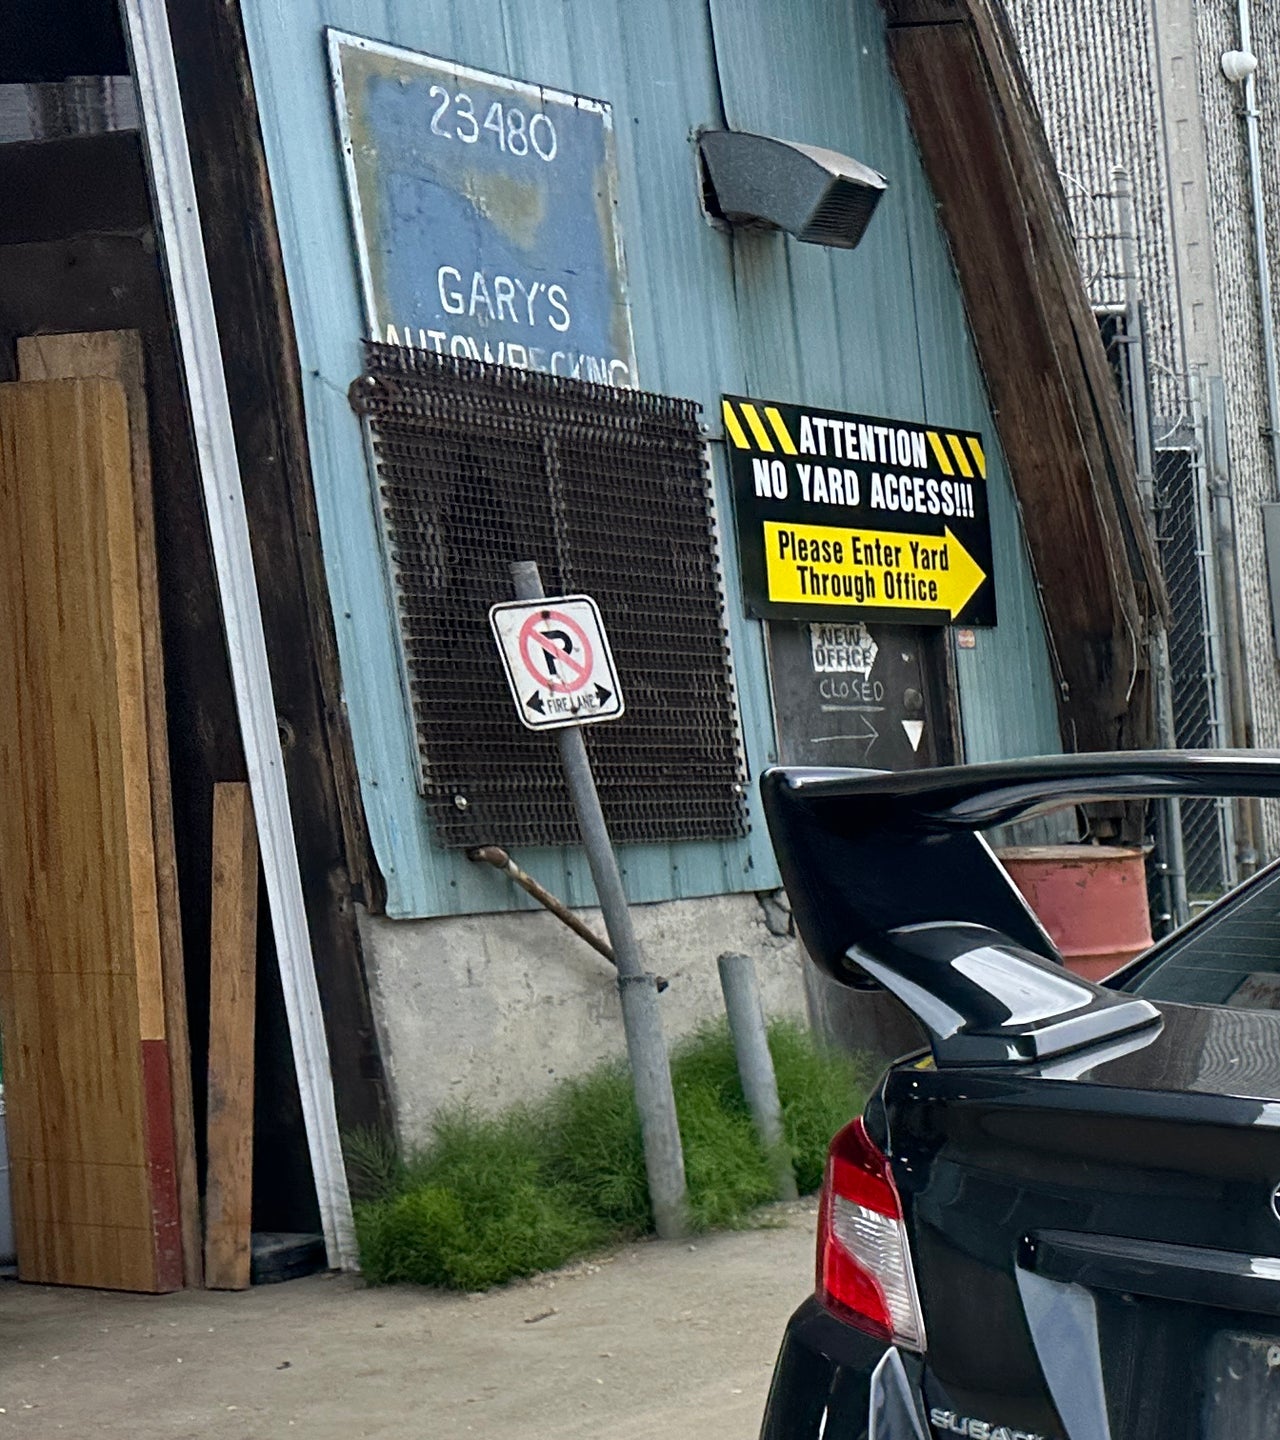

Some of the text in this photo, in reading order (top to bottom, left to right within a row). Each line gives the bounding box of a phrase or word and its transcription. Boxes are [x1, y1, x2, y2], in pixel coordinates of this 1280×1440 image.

[430, 86, 557, 162] 23480
[437, 266, 570, 332] GARY'S
[800, 415, 928, 469] ATTENTION
[752, 458, 975, 518] NO YARD ACCESS!!!
[778, 530, 949, 571] Please Enter Yard
[796, 565, 938, 603] Through Office
[547, 697, 570, 714] FIRE
[819, 679, 885, 702] CLOSED
